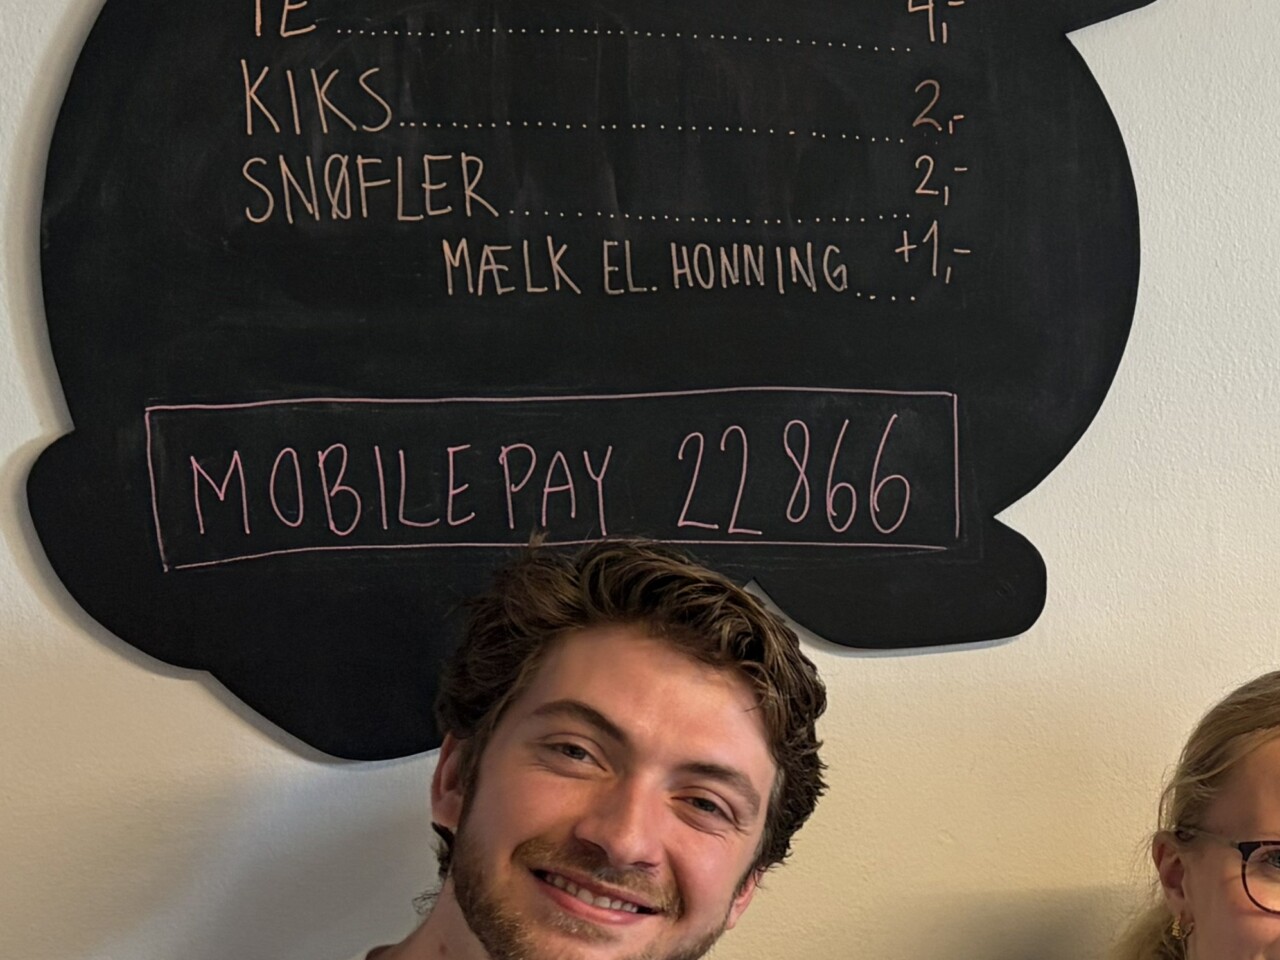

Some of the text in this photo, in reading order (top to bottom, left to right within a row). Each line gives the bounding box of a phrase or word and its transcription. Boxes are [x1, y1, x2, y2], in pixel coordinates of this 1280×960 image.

[241, 59, 392, 135] KIKS
[243, 152, 499, 224] SNØFLER
[442, 236, 581, 296] MÆLK
[603, 240, 658, 294] EL.
[671, 242, 848, 294] HONNING
[190, 442, 613, 536] MOBILEPAY
